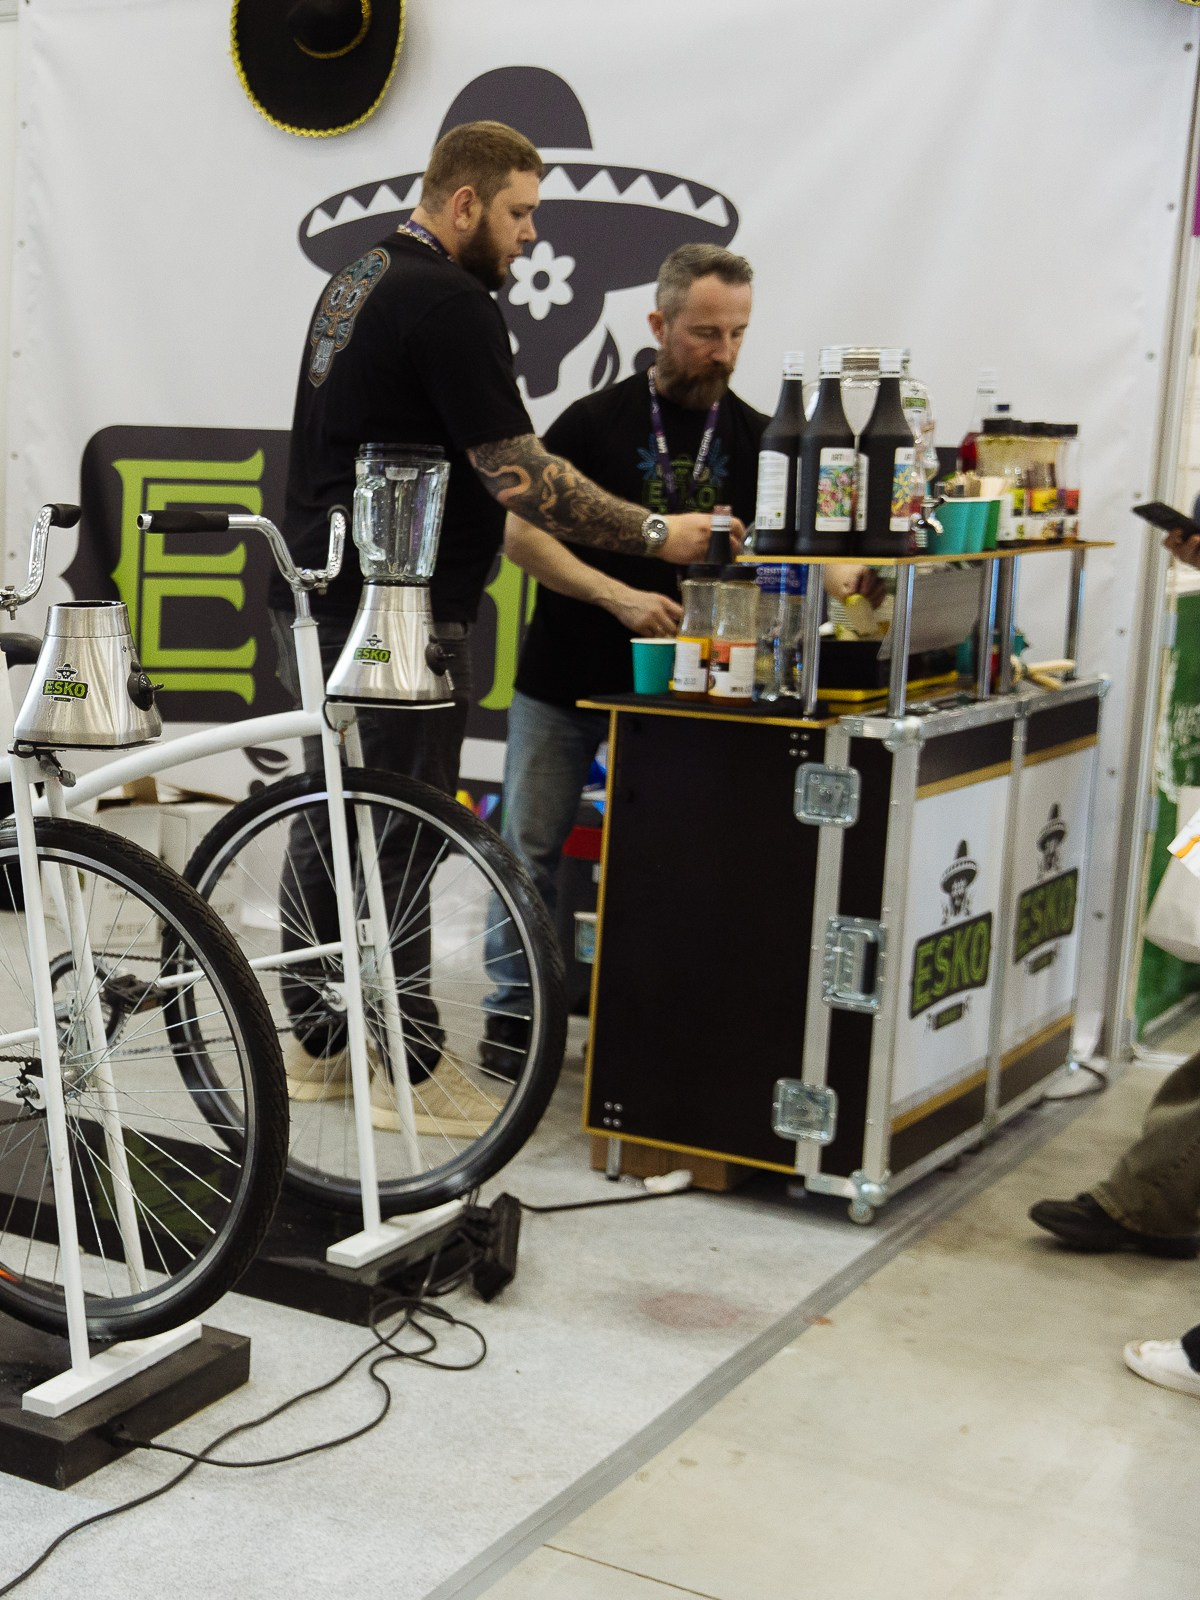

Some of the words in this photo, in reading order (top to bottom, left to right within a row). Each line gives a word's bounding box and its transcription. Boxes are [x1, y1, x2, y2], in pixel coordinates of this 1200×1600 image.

[354, 648, 390, 662] ESKO
[44, 680, 86, 698] ESKO
[1015, 874, 1076, 958] ESKO
[912, 918, 989, 1009] ESKO
